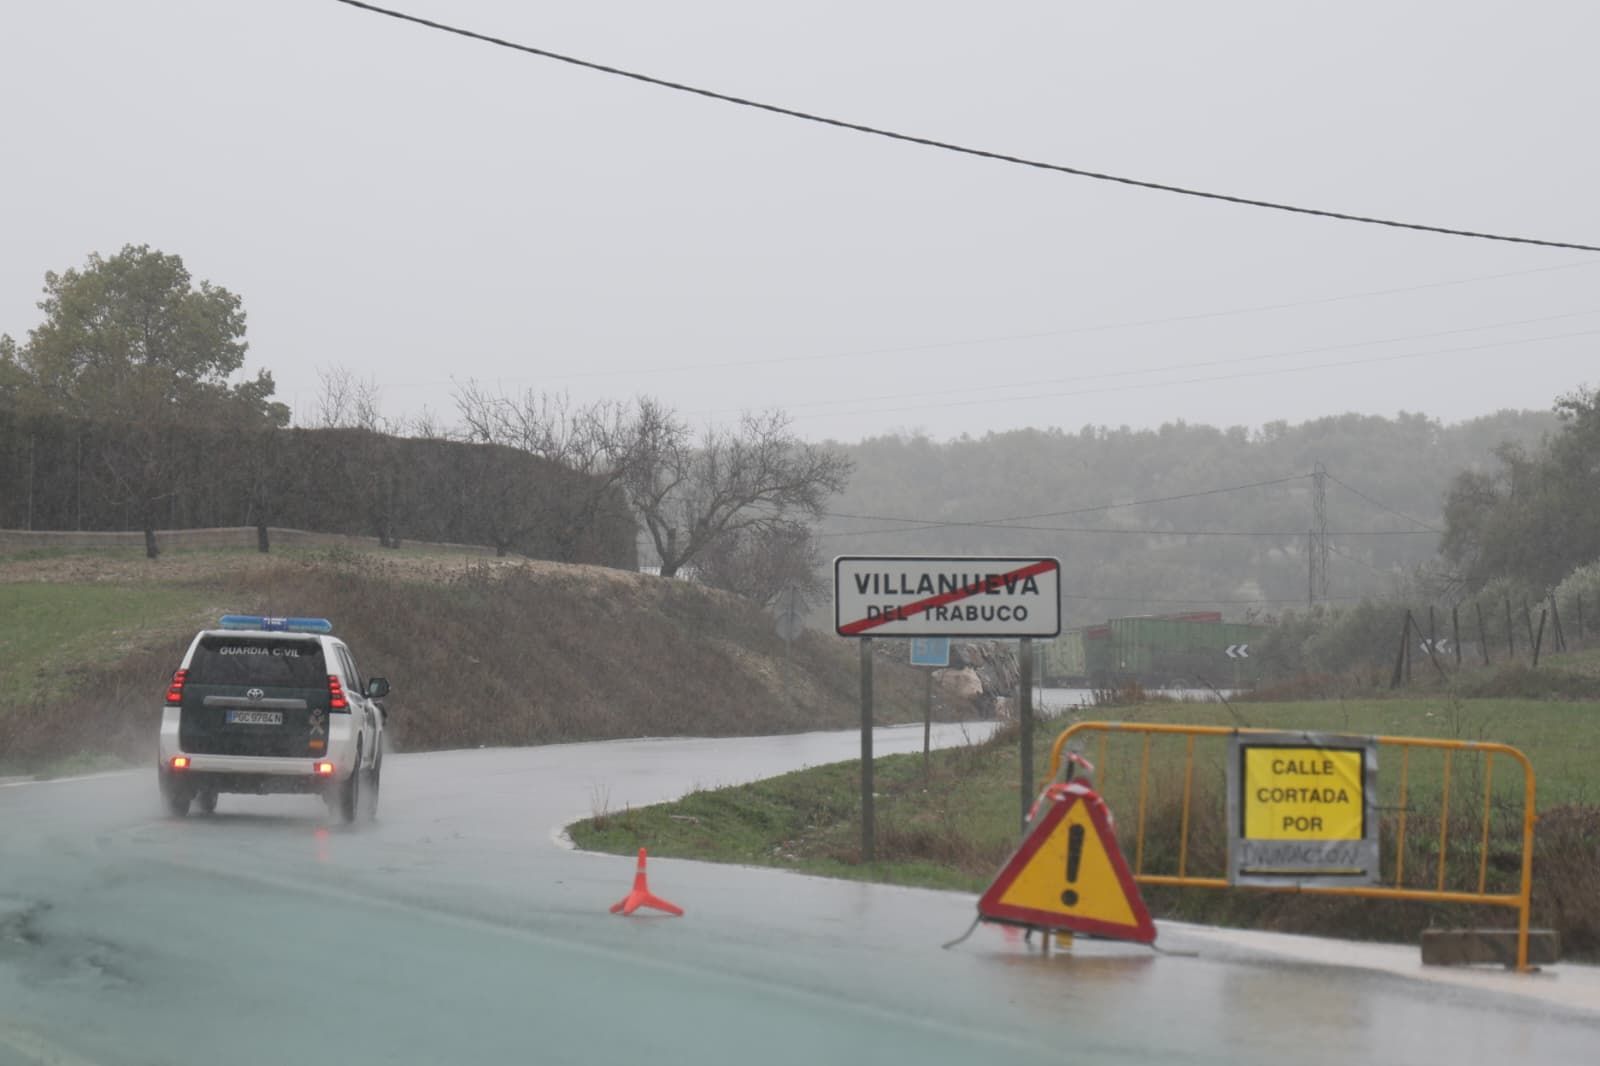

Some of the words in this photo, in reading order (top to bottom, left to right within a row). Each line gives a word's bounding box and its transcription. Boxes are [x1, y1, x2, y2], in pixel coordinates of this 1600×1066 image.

[855, 573, 1039, 595] VILLANUEVA
[867, 605, 908, 621] DEL
[924, 605, 1028, 622] TRABUCO
[220, 646, 269, 656] GUARDIA
[1272, 760, 1334, 775] CALLE
[1257, 788, 1349, 804] CORTADA
[1283, 817, 1323, 832] POR
